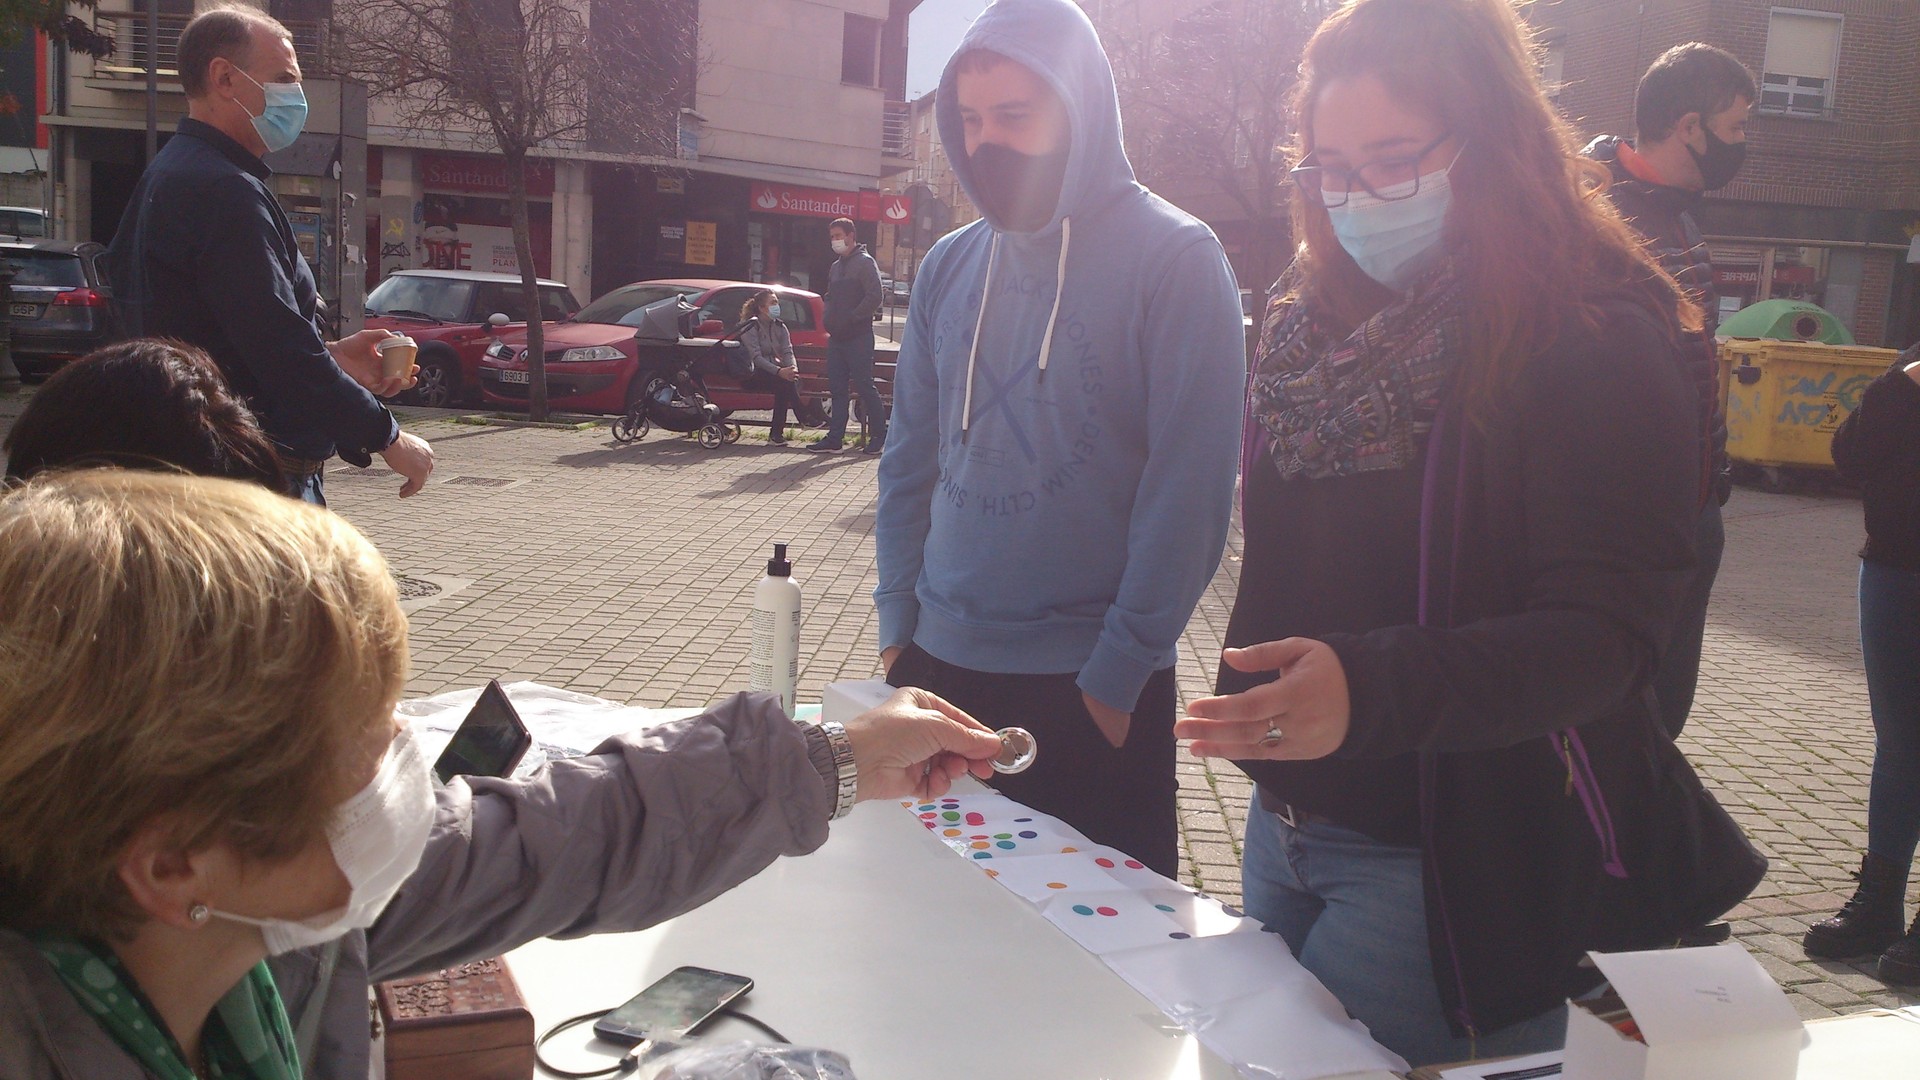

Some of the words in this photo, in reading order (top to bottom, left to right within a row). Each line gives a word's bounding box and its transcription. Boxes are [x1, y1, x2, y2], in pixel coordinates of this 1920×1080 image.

[429, 163, 508, 187] Santand
[781, 191, 855, 216] Santander
[492, 258, 517, 267] PLAN
[1058, 310, 1103, 395] JONES
[504, 371, 522, 382] 6903
[1041, 422, 1101, 497] DENIM
